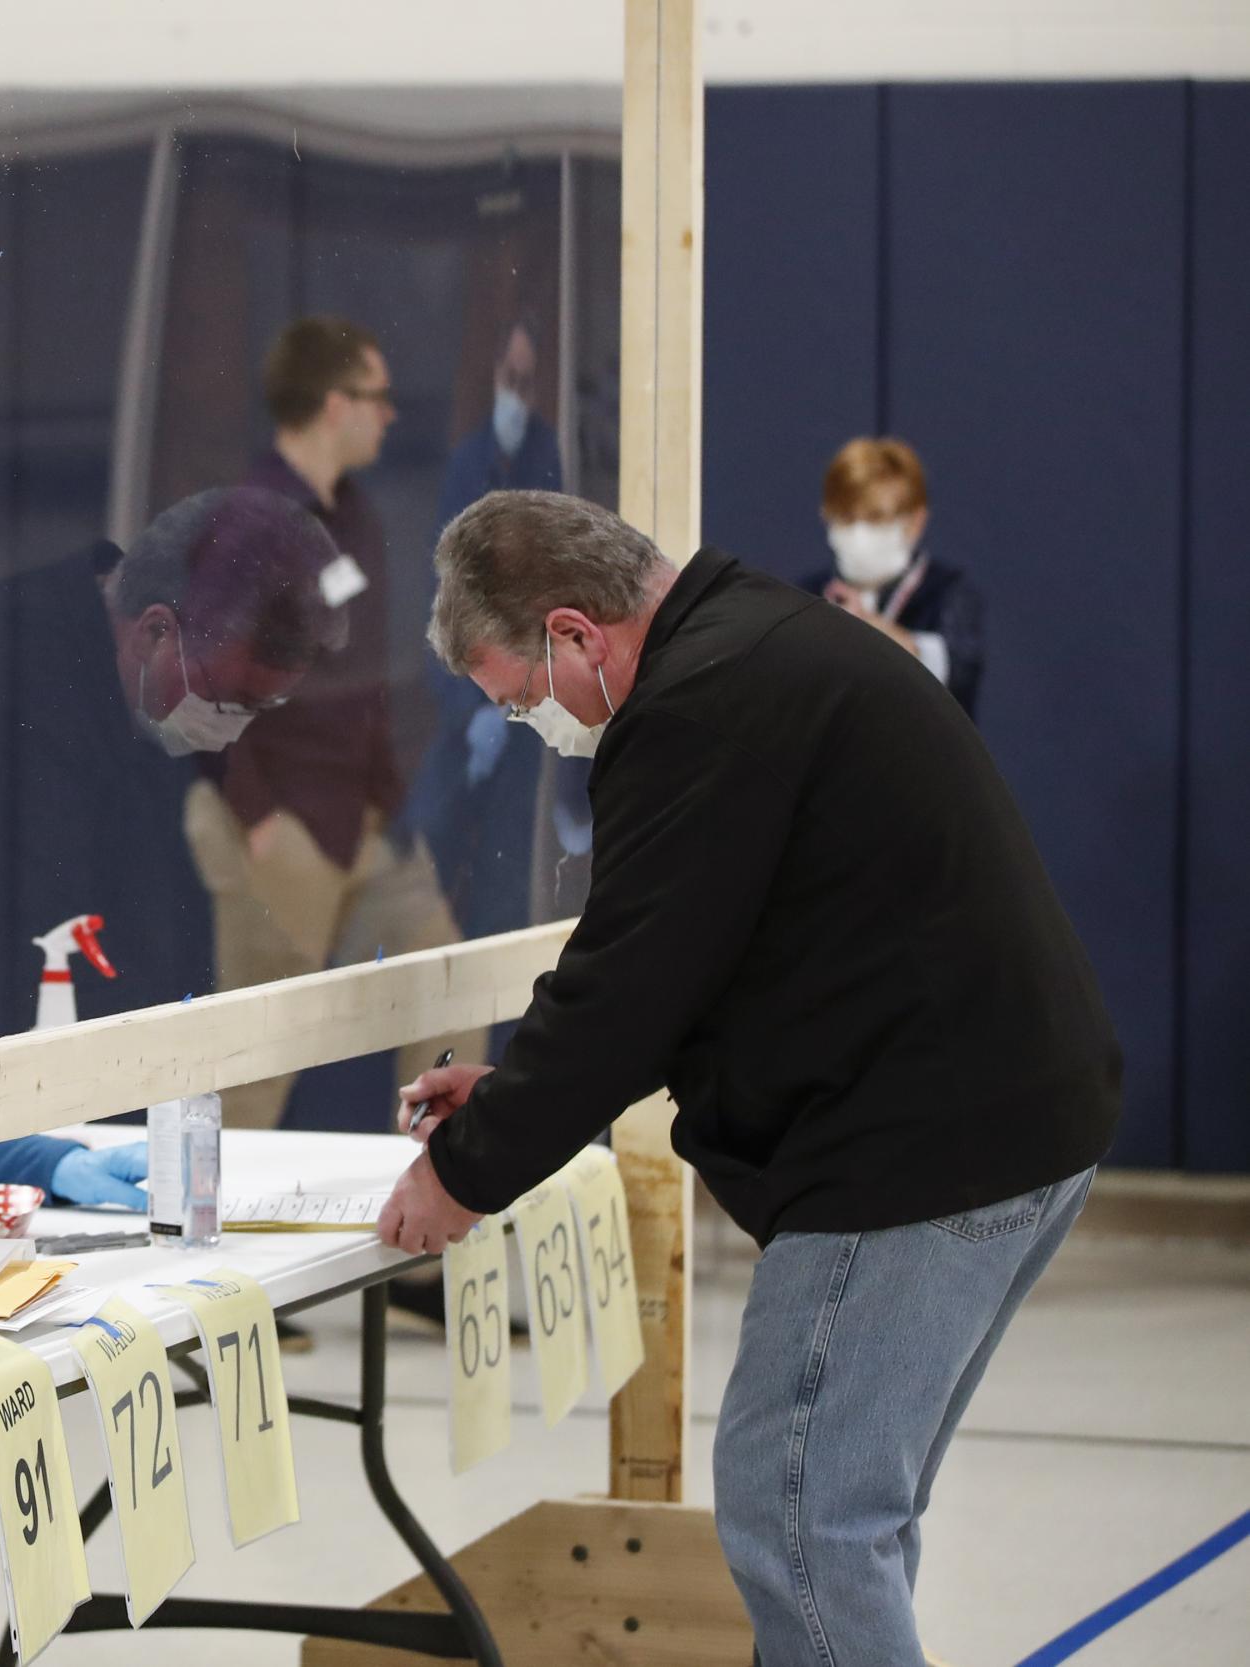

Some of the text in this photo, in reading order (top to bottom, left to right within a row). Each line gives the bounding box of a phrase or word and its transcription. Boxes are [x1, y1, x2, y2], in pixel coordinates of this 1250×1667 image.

[535, 1221, 575, 1337] 63
[589, 1197, 629, 1309] 54
[460, 1268, 501, 1378] 65
[216, 1322, 275, 1442] 71
[14, 1438, 54, 1546] 91
[111, 1371, 173, 1510] 72
